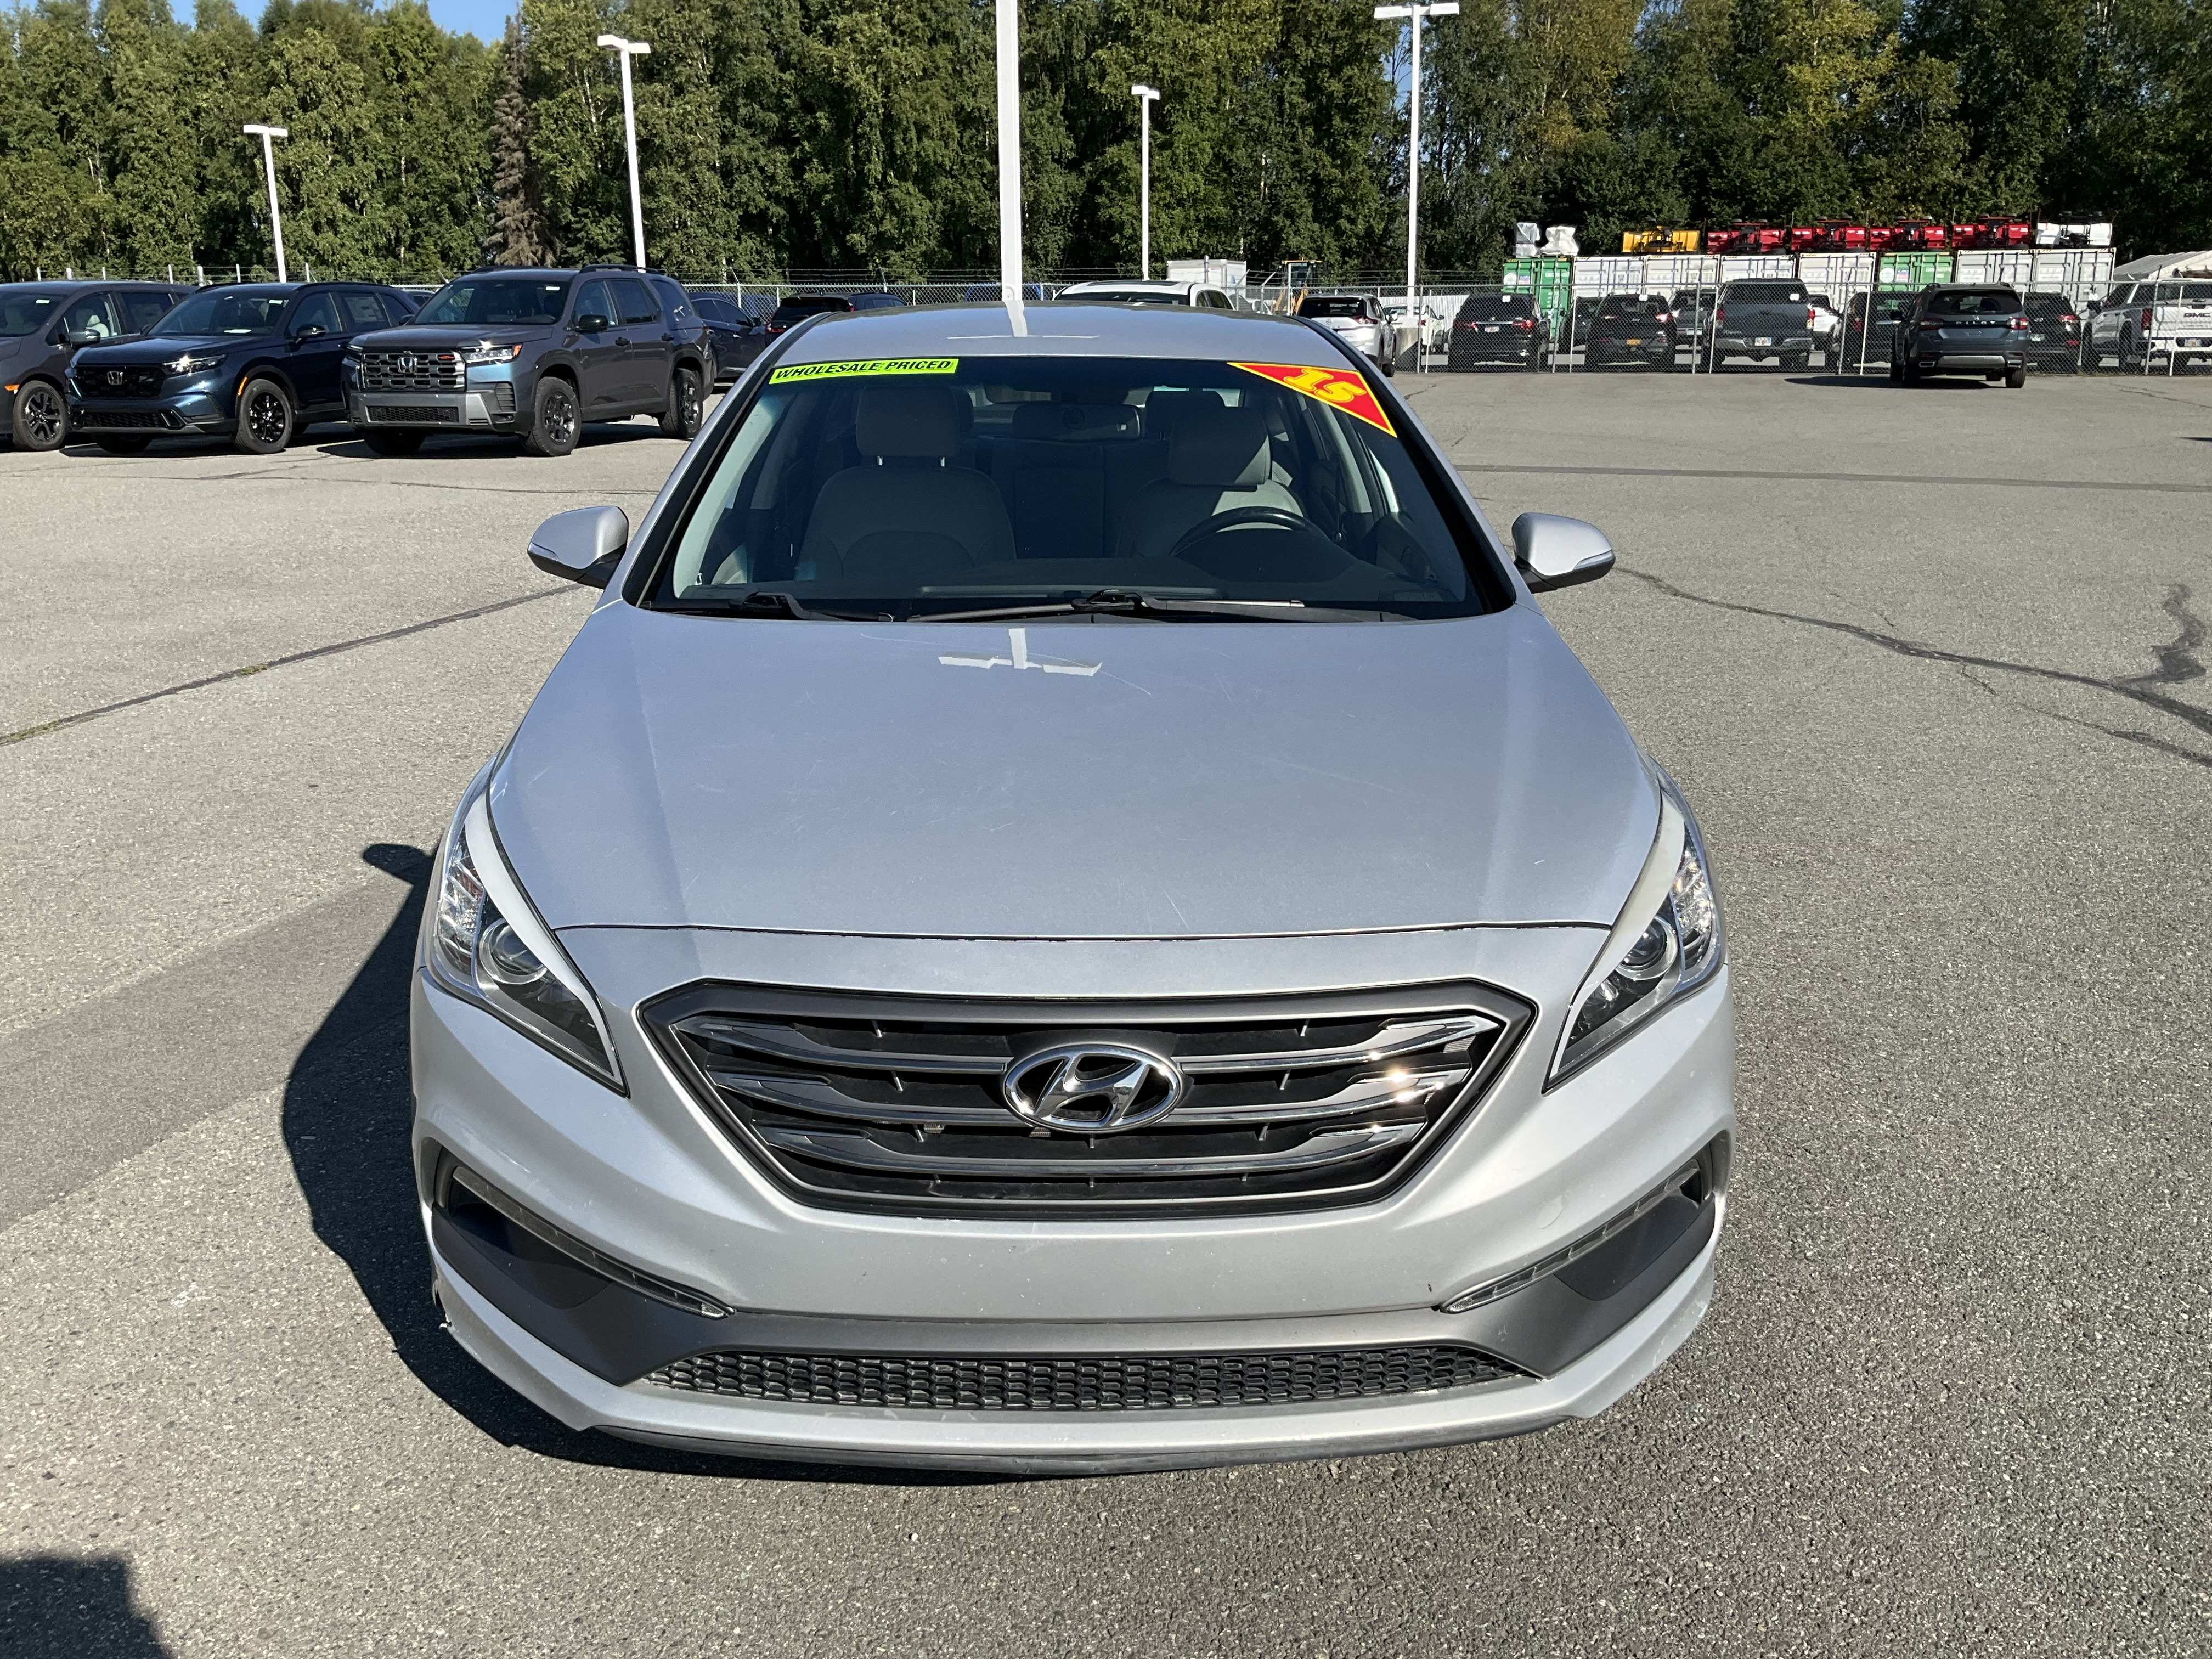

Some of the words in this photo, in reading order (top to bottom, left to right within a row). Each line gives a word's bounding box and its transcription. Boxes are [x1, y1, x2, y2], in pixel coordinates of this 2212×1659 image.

[775, 362, 882, 380] WHOLESALE
[884, 360, 953, 370] PRICED
[1283, 369, 1367, 403] 15
